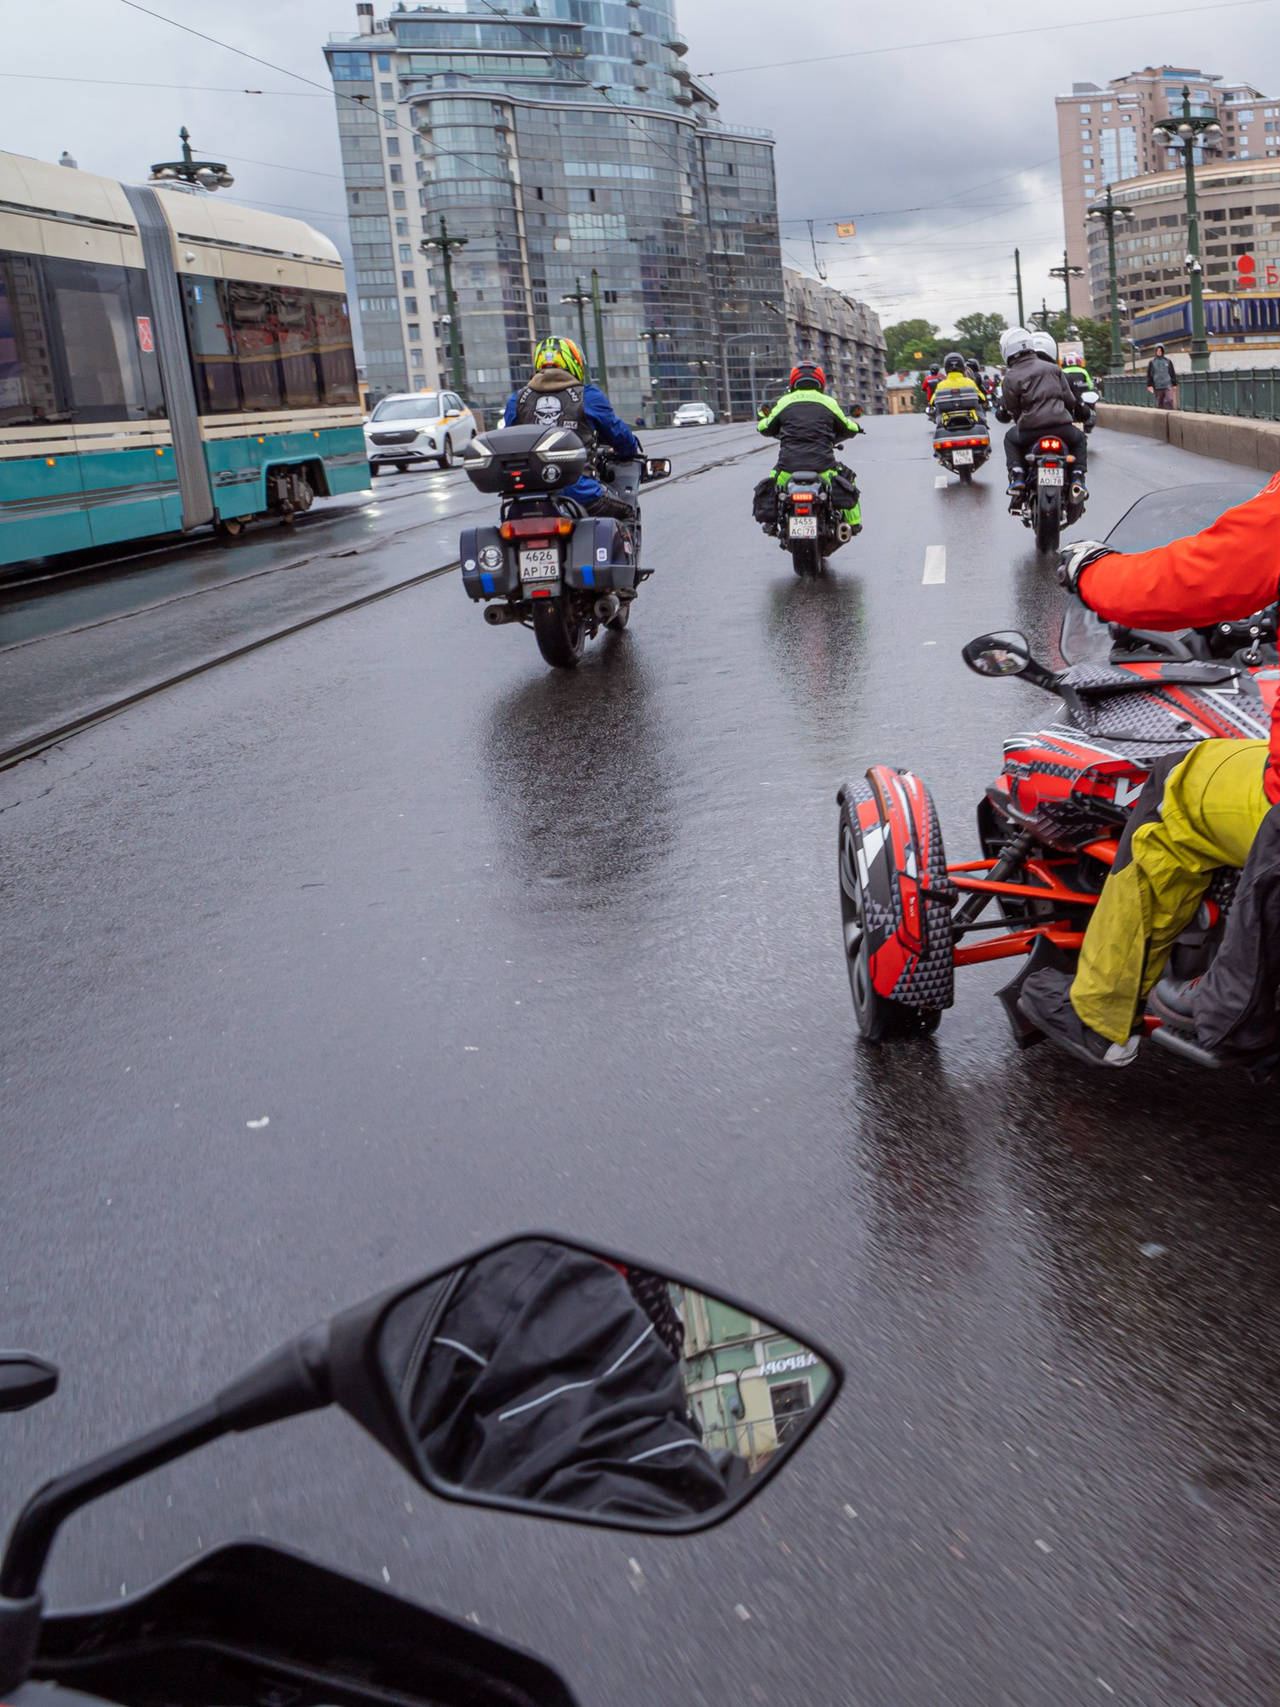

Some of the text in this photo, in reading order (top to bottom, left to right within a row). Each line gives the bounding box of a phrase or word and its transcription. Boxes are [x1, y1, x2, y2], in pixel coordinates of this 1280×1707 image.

[793, 518, 813, 526] 3455
[806, 528, 815, 536] 78
[525, 551, 553, 562] 4626
[543, 565, 557, 575] 78
